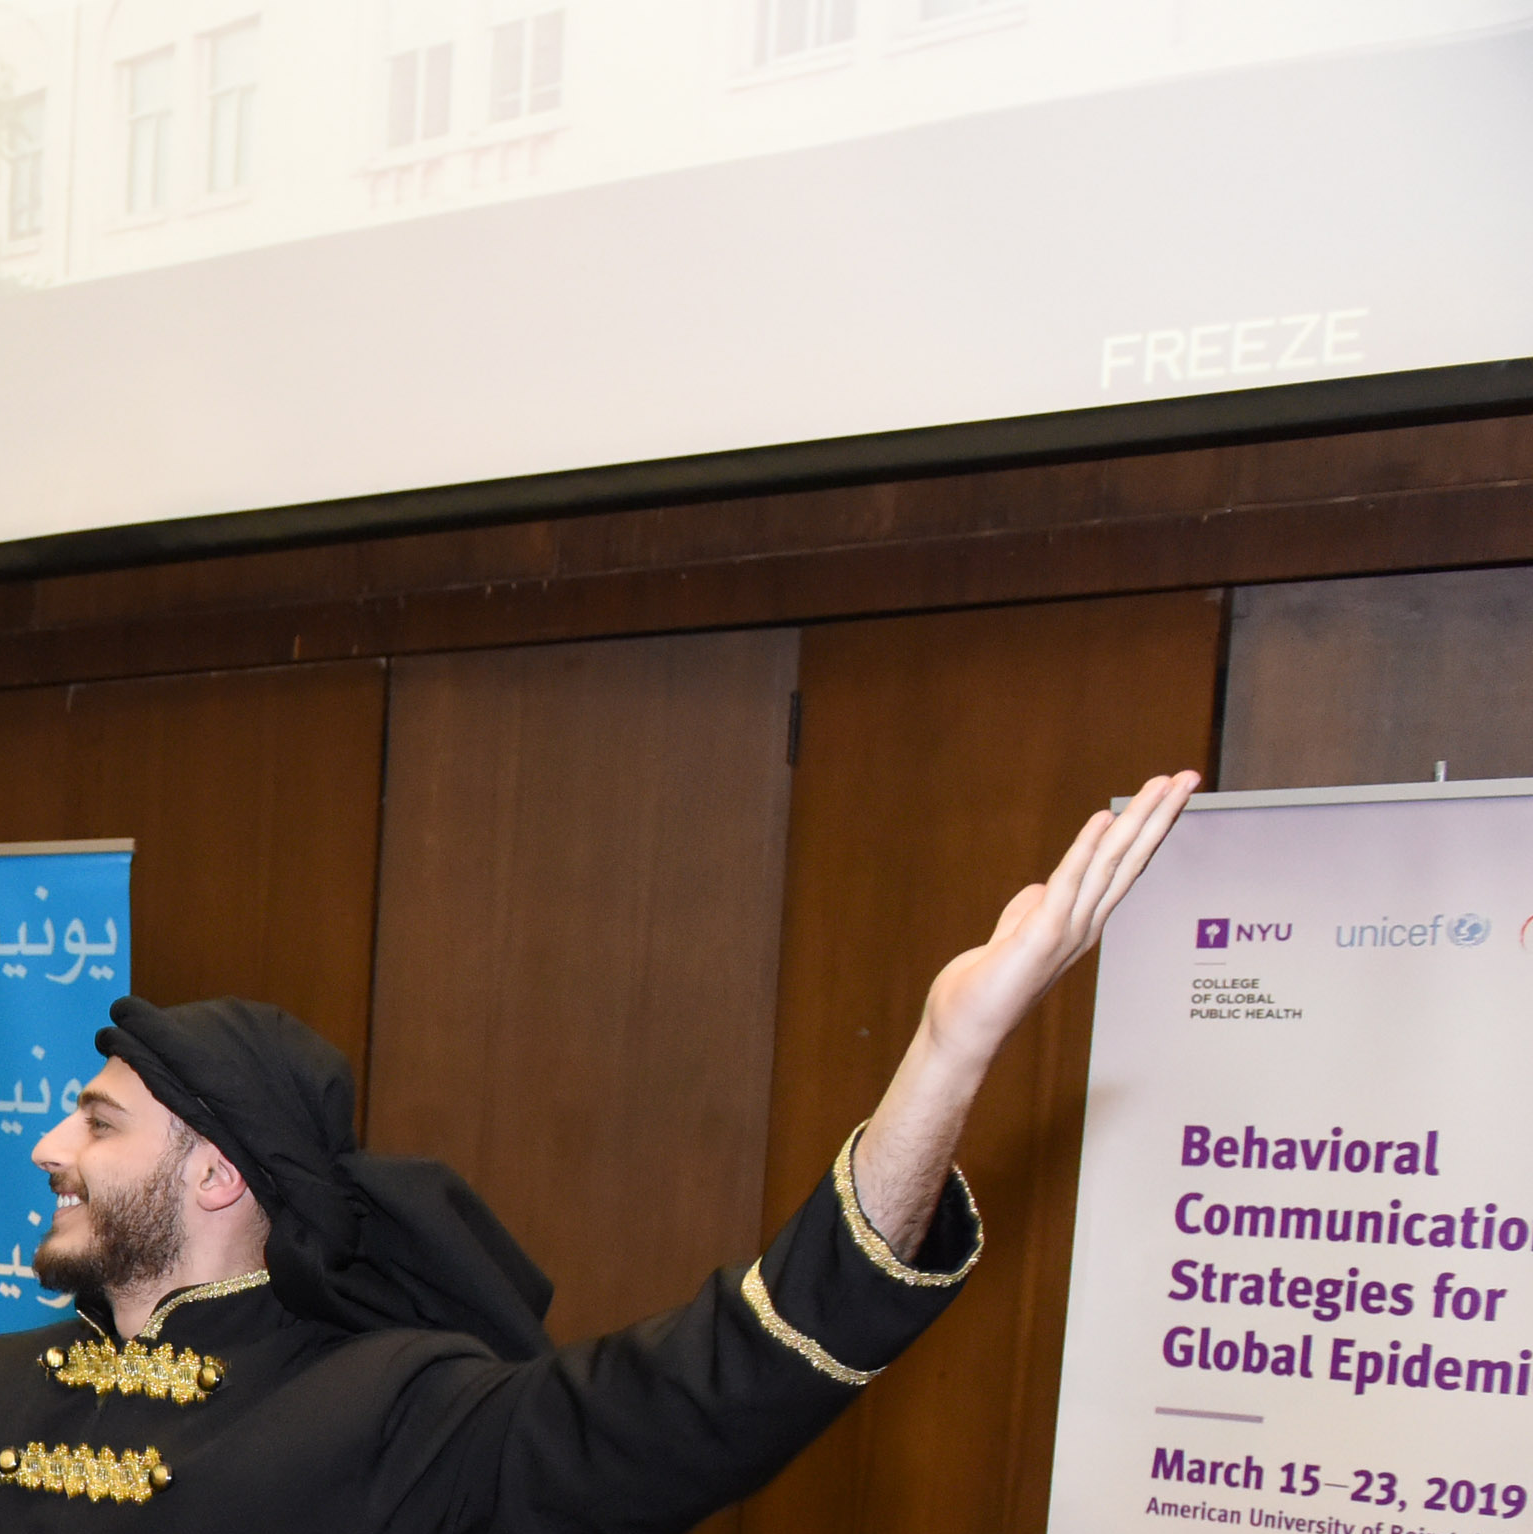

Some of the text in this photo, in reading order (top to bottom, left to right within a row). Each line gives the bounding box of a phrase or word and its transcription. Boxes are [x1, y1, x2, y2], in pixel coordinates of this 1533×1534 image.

[1100, 307, 1370, 390] FREEZE
[1235, 923, 1293, 942] NYU
[1335, 914, 1444, 948] unicef
[1191, 993, 1275, 1005] OF GLOBAL
[1192, 978, 1260, 990] COLLEGE
[1190, 1008, 1303, 1020] PUBLIC HEALTH
[1181, 1125, 1440, 1176] Behavioral
[1174, 1191, 1533, 1252] Communicatio
[1168, 1259, 1508, 1322] Strategies for
[1162, 1326, 1313, 1379] Global
[1150, 1447, 1264, 1491] March
[1423, 1477, 1527, 1520] 2019
[1145, 1497, 1242, 1525] American
